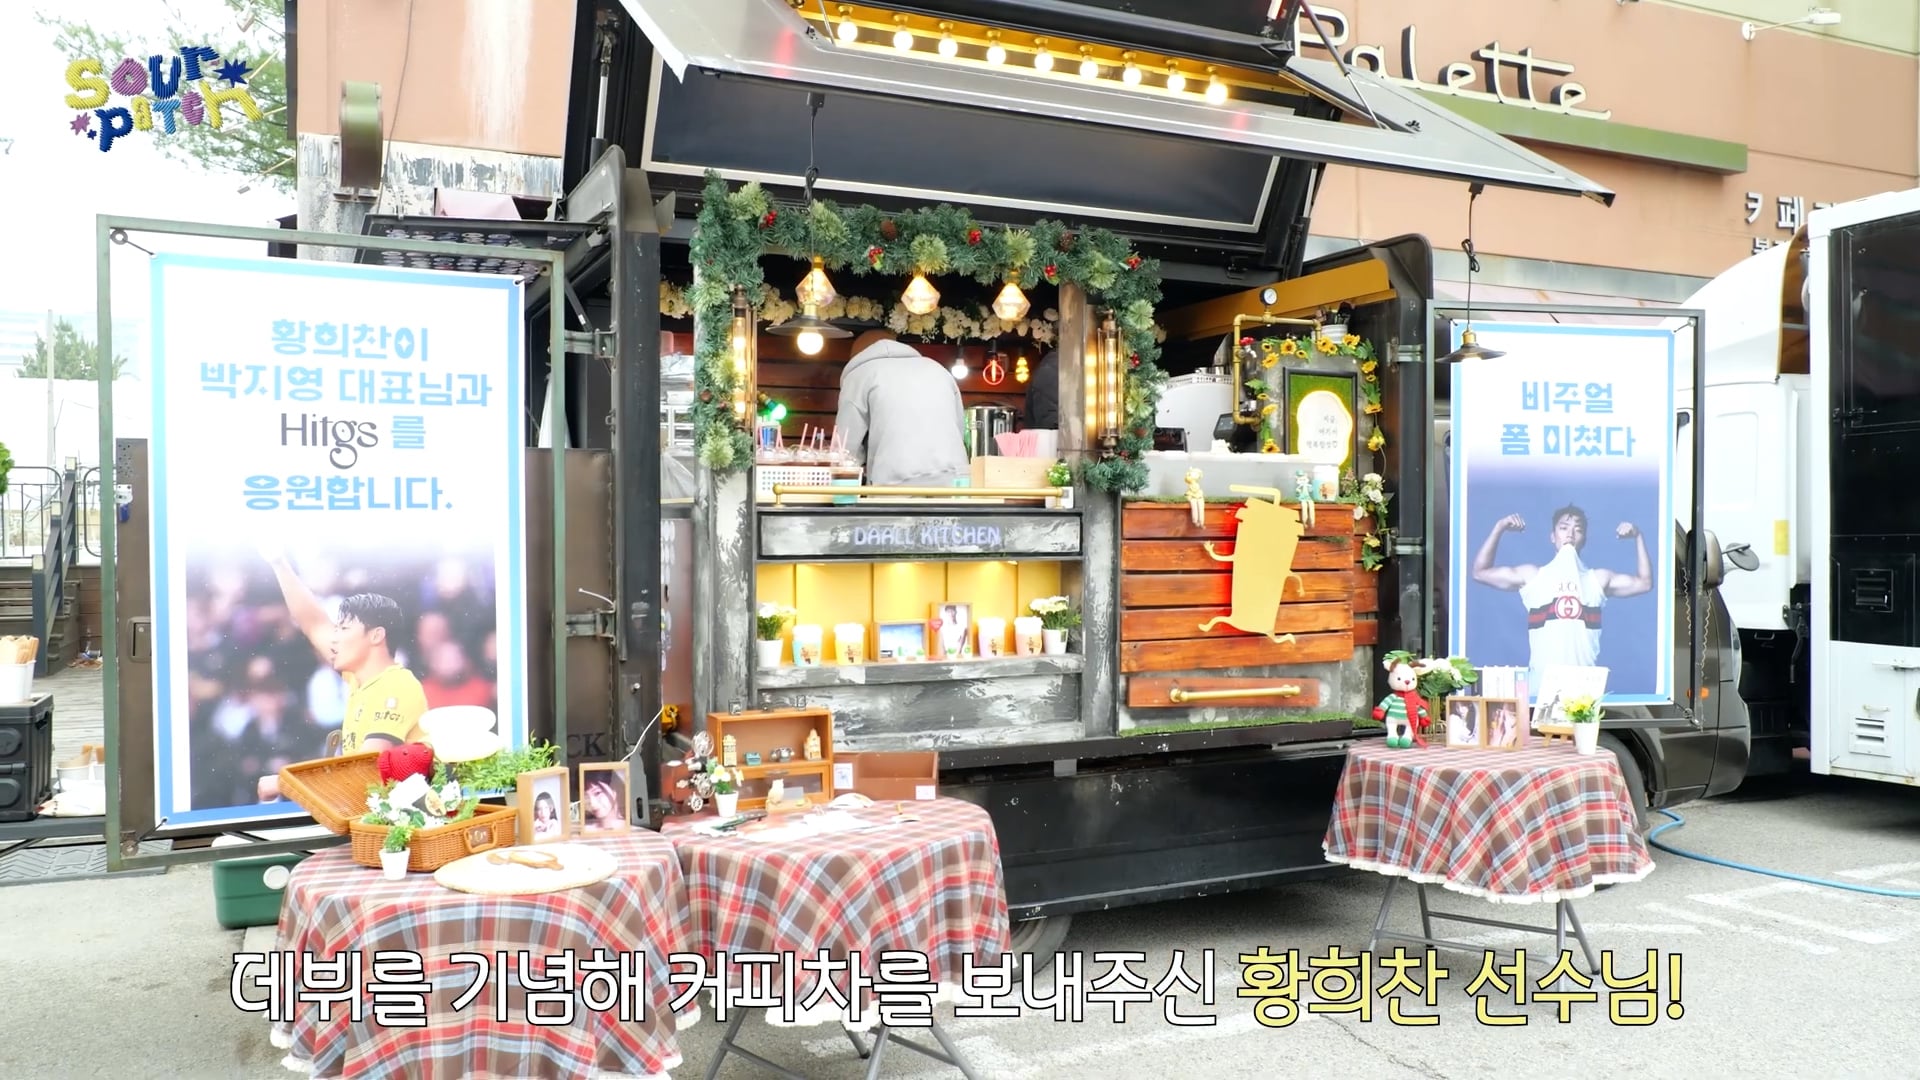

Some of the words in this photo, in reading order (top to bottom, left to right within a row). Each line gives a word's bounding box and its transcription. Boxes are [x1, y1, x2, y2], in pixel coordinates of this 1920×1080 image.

[1293, 4, 1612, 121] Palette
[271, 318, 428, 362] 황희찬이
[200, 362, 324, 402] 박지영
[338, 368, 493, 407] 대표님과
[1521, 381, 1614, 413] 비주얼
[280, 412, 379, 470] Hitgs
[390, 415, 426, 450] 를
[1500, 423, 1531, 456] 폼
[1543, 424, 1636, 458] 미쳤다
[242, 474, 453, 511] 응원합니다.
[854, 526, 914, 546] DAALL
[920, 526, 1000, 546] KITCHEN
